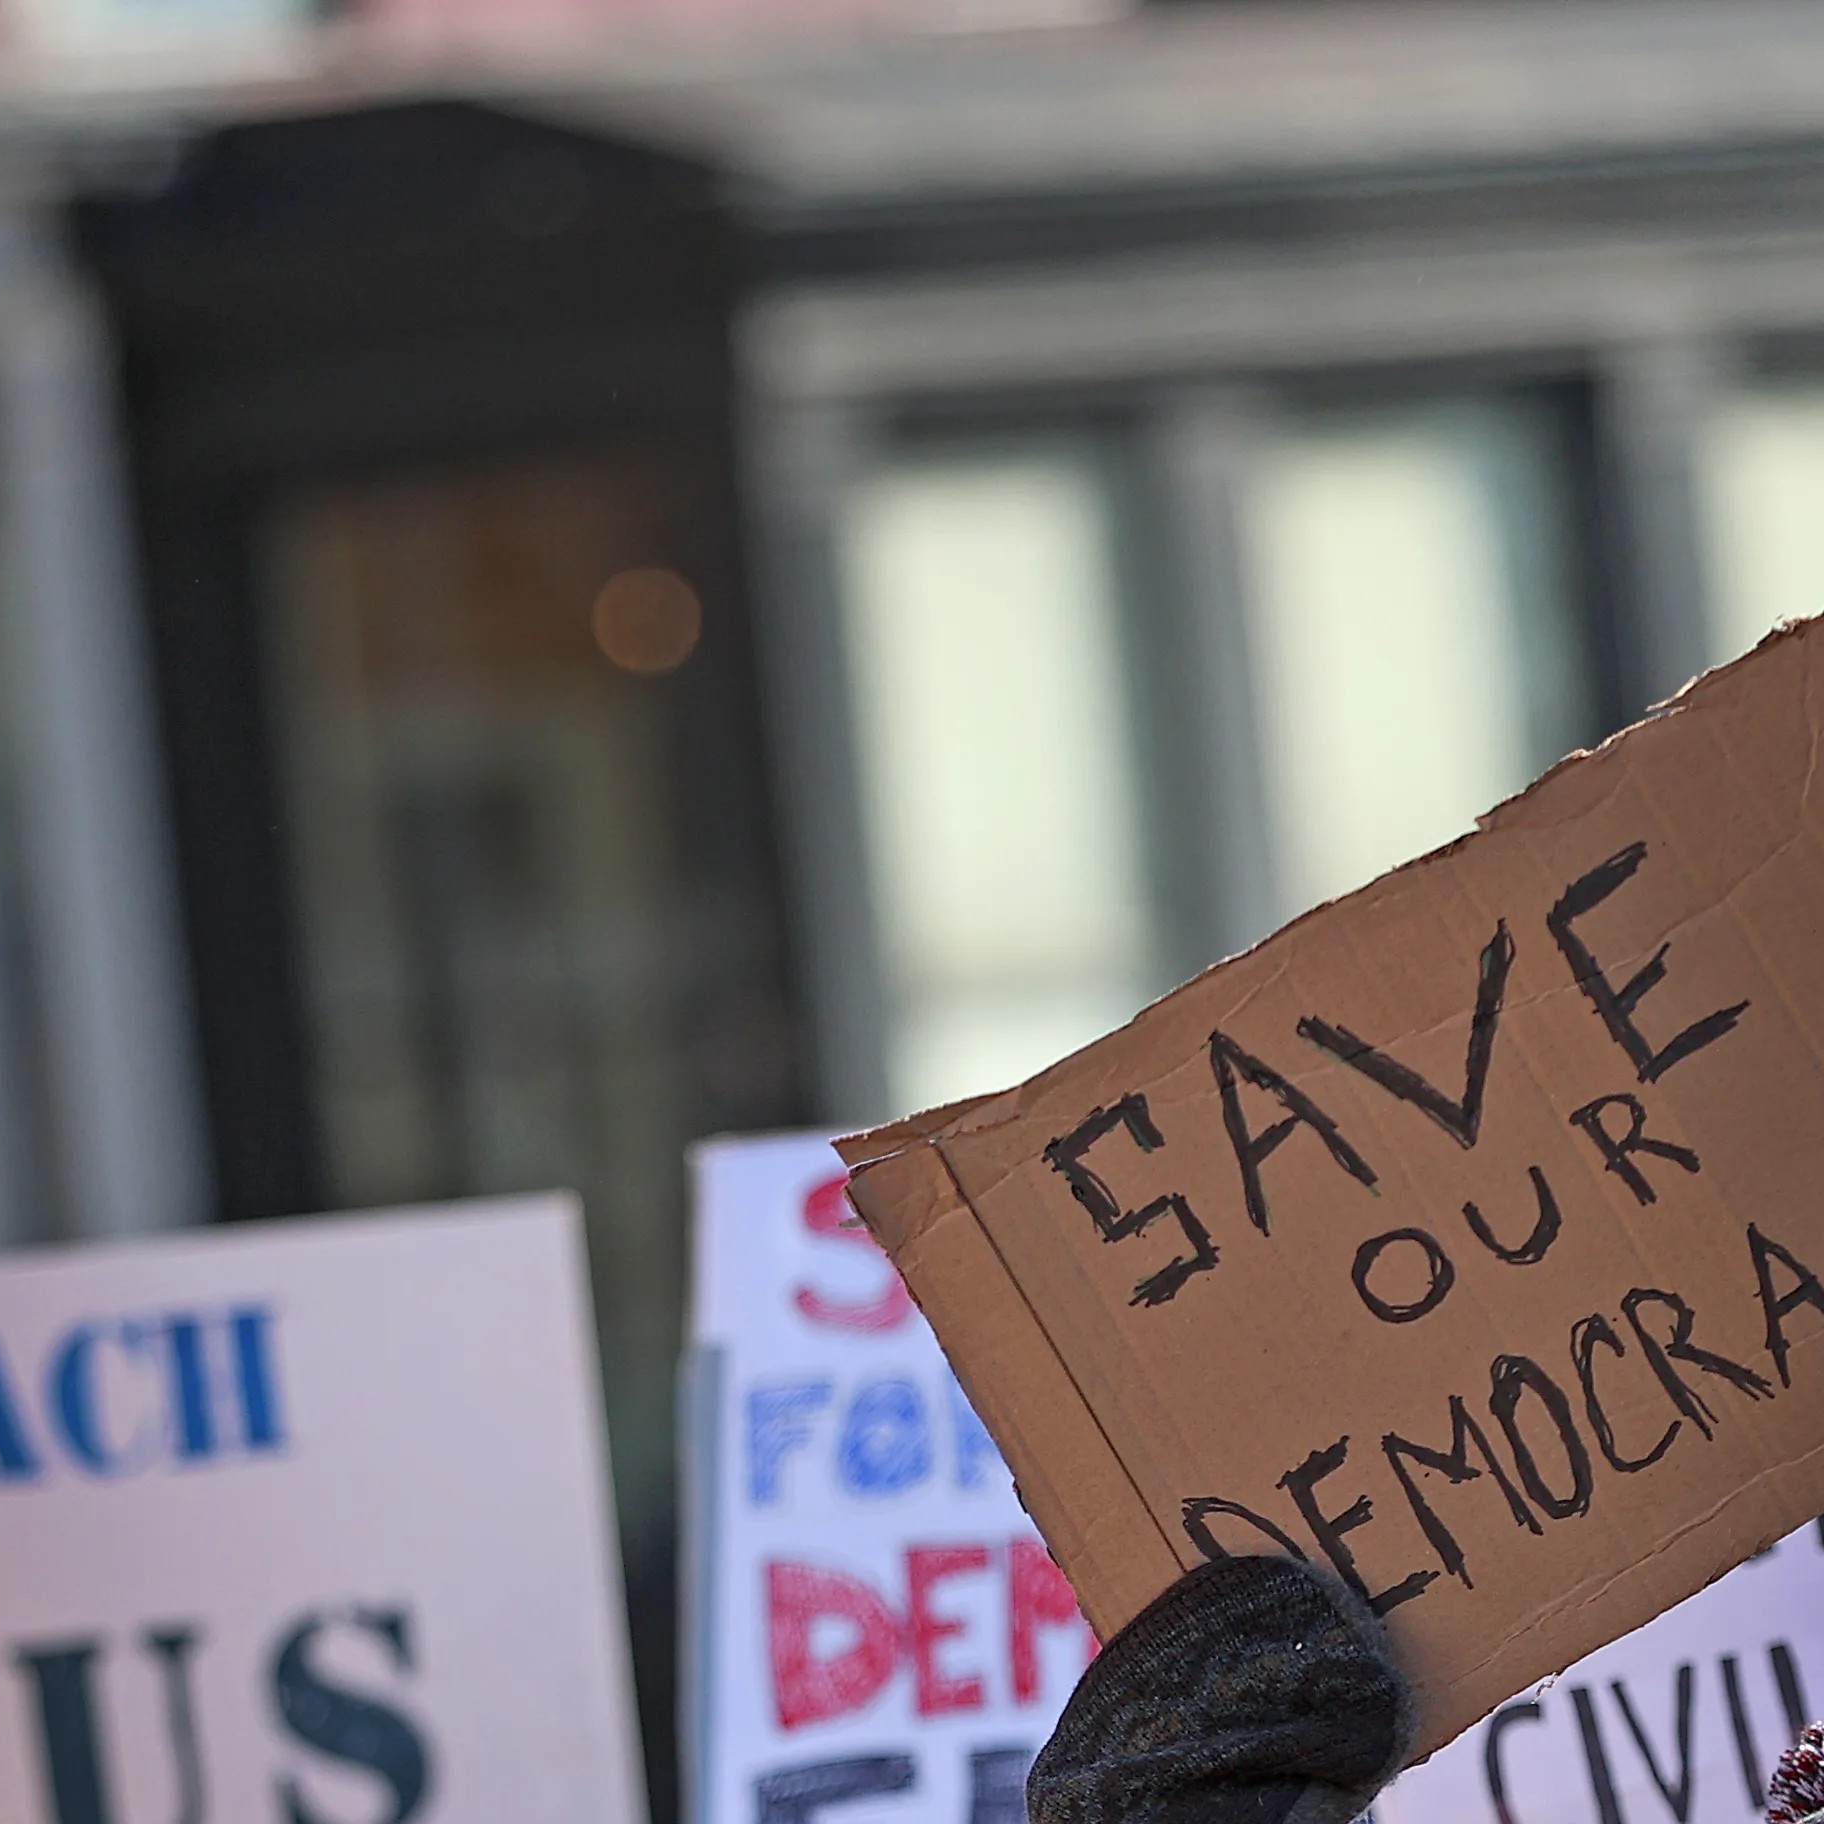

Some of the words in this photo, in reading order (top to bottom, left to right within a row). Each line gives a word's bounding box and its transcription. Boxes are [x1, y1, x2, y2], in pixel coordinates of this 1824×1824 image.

[1042, 841, 1750, 1308] SAVE
[1352, 1092, 1700, 1323] OUR
[766, 1540, 1102, 1733] DEM
